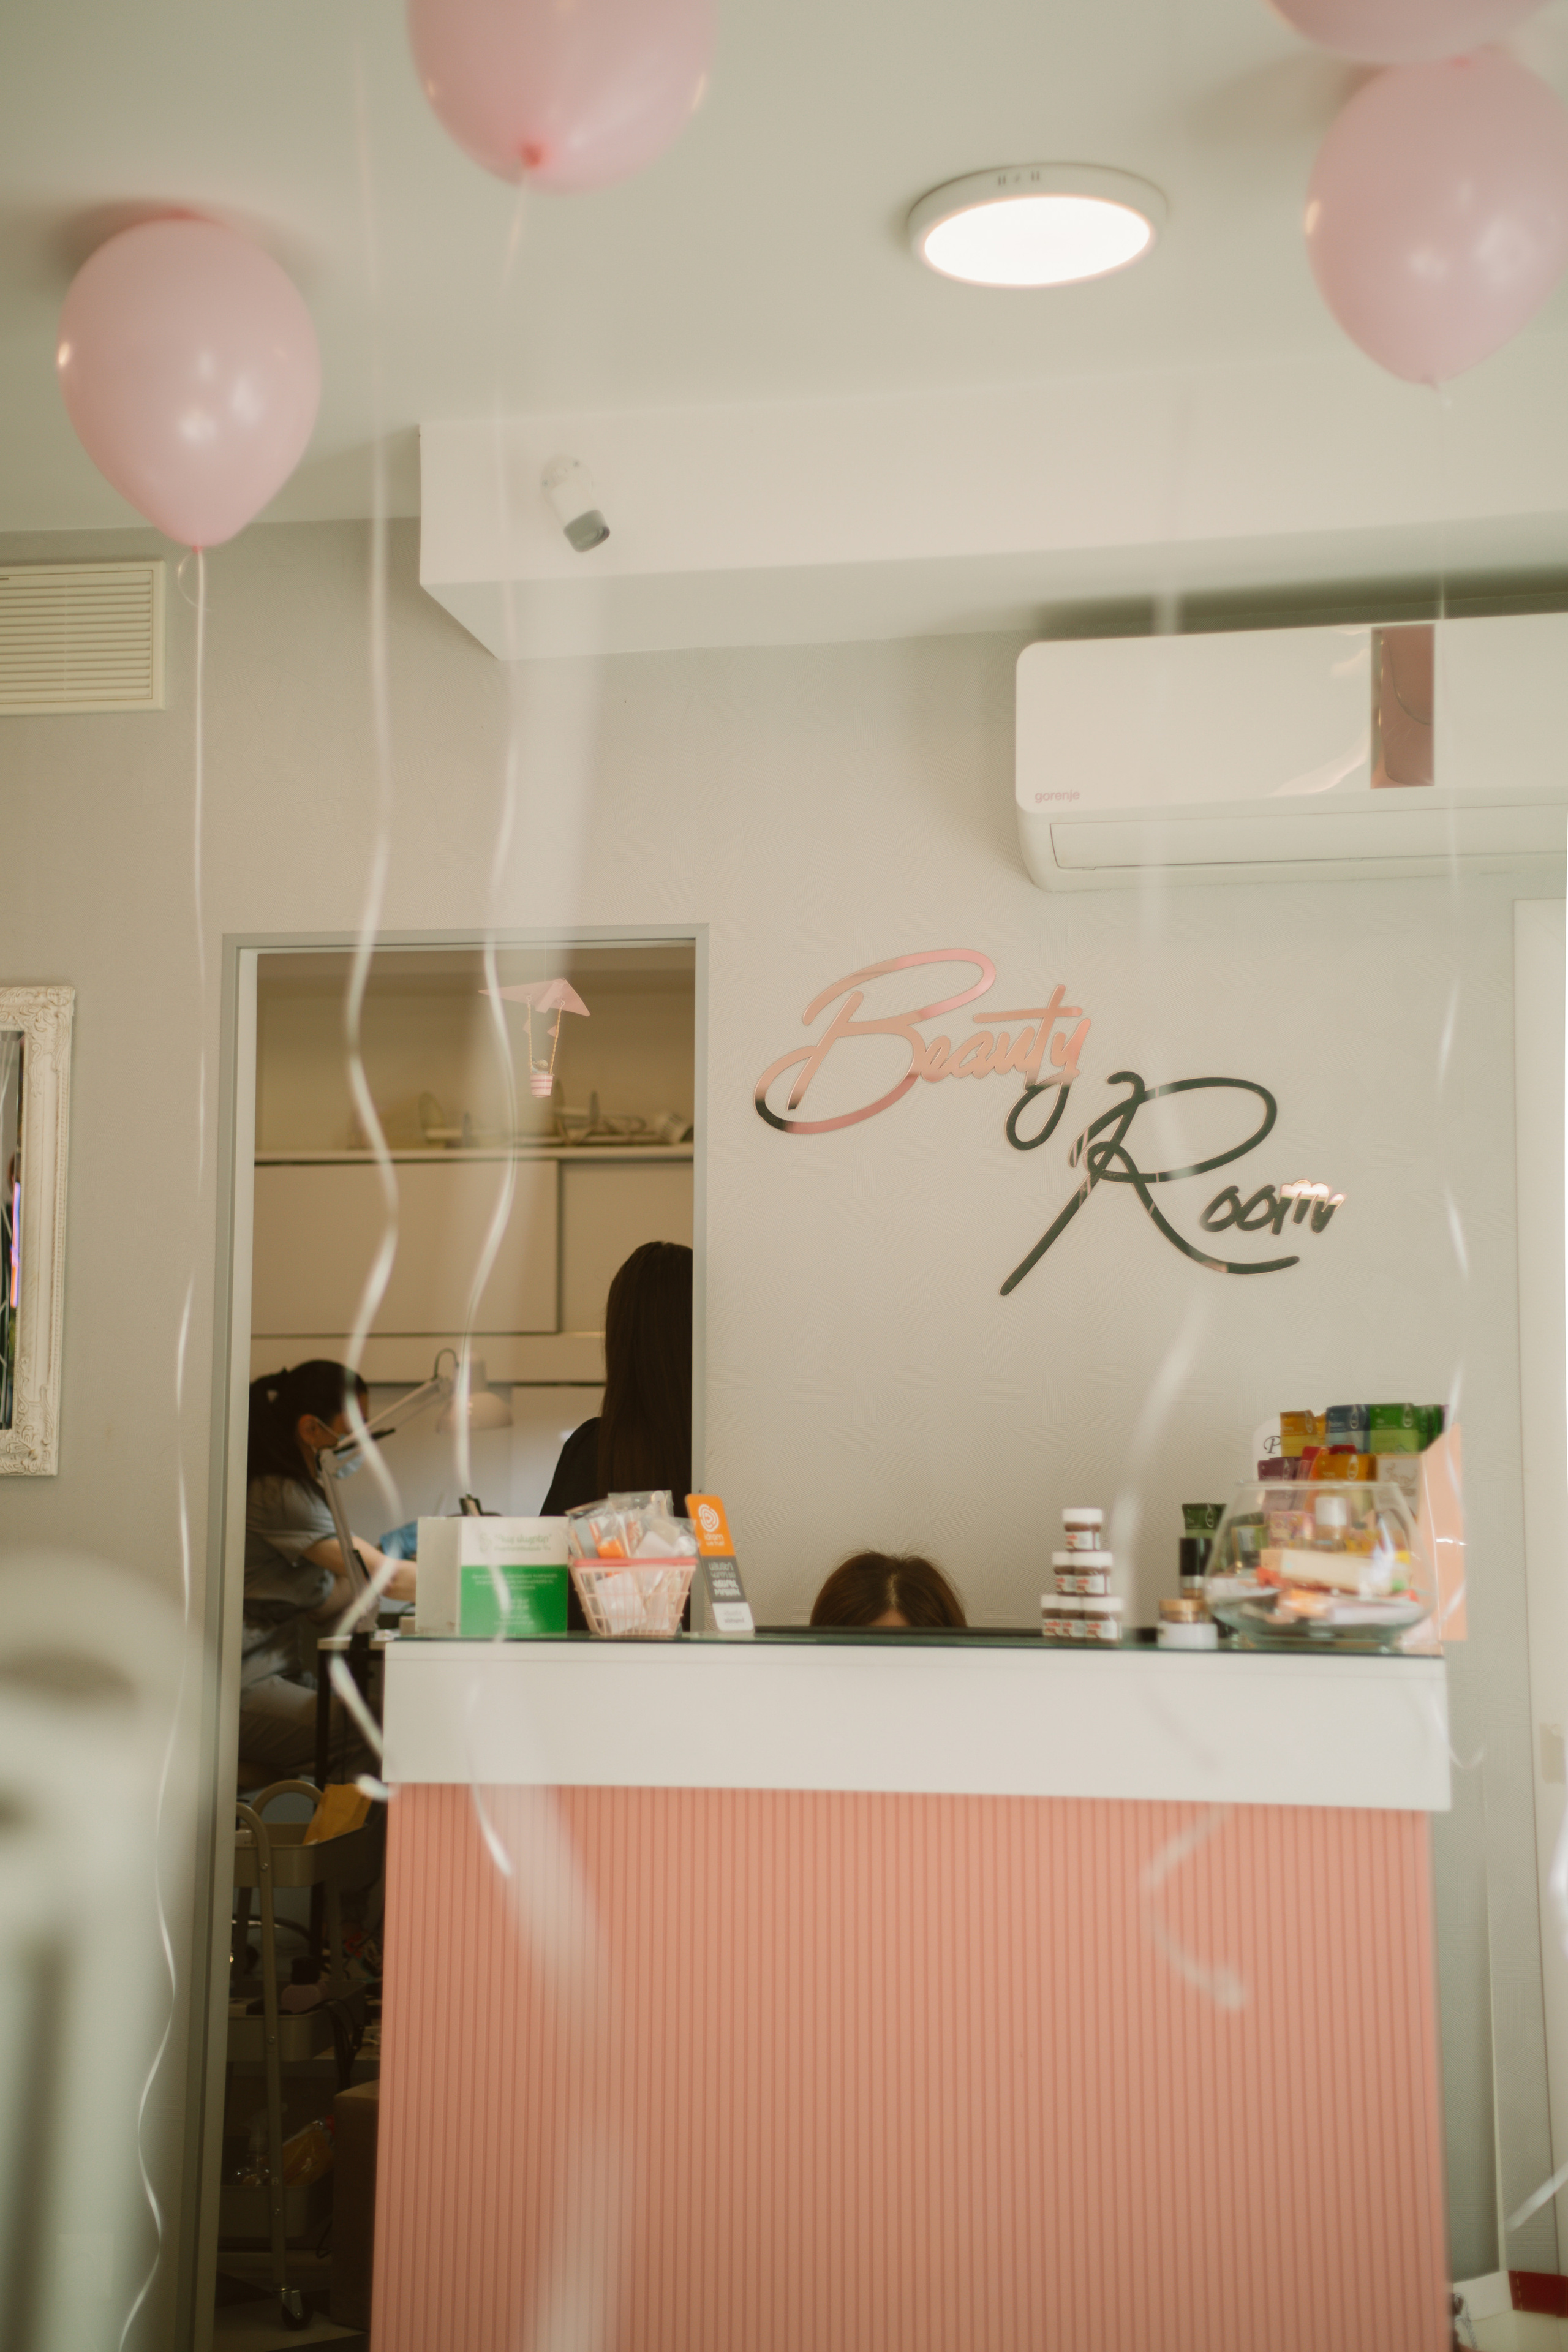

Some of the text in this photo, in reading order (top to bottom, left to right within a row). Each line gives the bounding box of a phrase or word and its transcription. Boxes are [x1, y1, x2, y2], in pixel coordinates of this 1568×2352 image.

[1035, 789, 1080, 803] gorenje
[754, 948, 1091, 1151] Beauty
[999, 1071, 1346, 1296] Room
